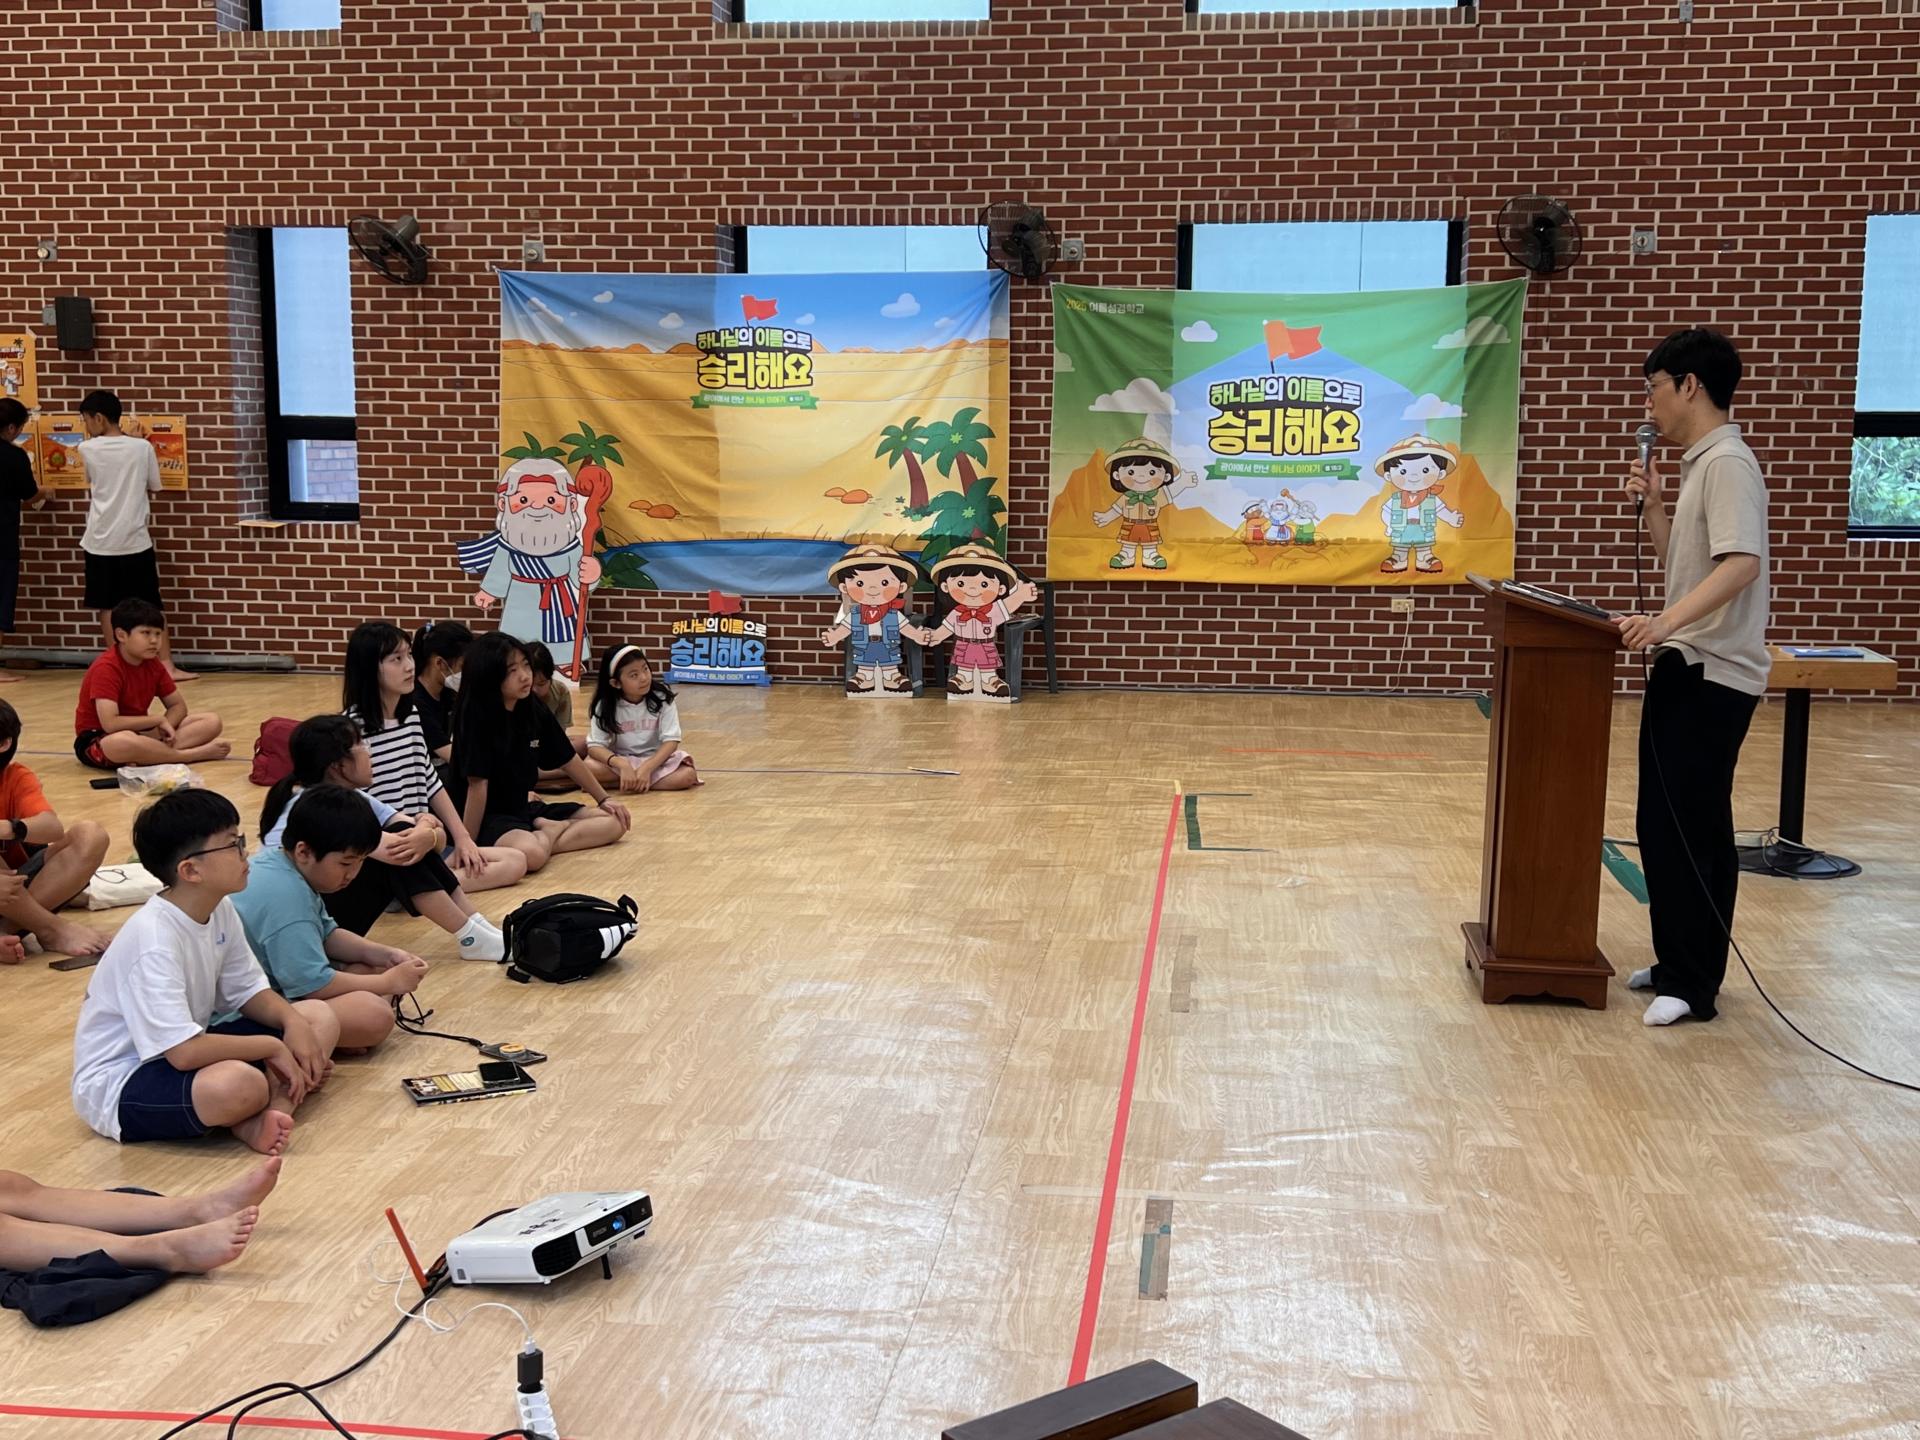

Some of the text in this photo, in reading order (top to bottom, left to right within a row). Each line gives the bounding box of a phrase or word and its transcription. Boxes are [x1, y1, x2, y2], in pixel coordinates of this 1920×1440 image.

[697, 327, 812, 351] 하나님의 이름으로
[698, 350, 813, 388] 승리해요
[1210, 376, 1361, 406] 하나님의 이름으로
[1209, 406, 1361, 455] 승리해요
[1271, 463, 1295, 474] 하나님
[1296, 463, 1321, 473] 이야기
[672, 617, 767, 638] 하나님의 이름으로
[670, 636, 766, 667] 승리해요
